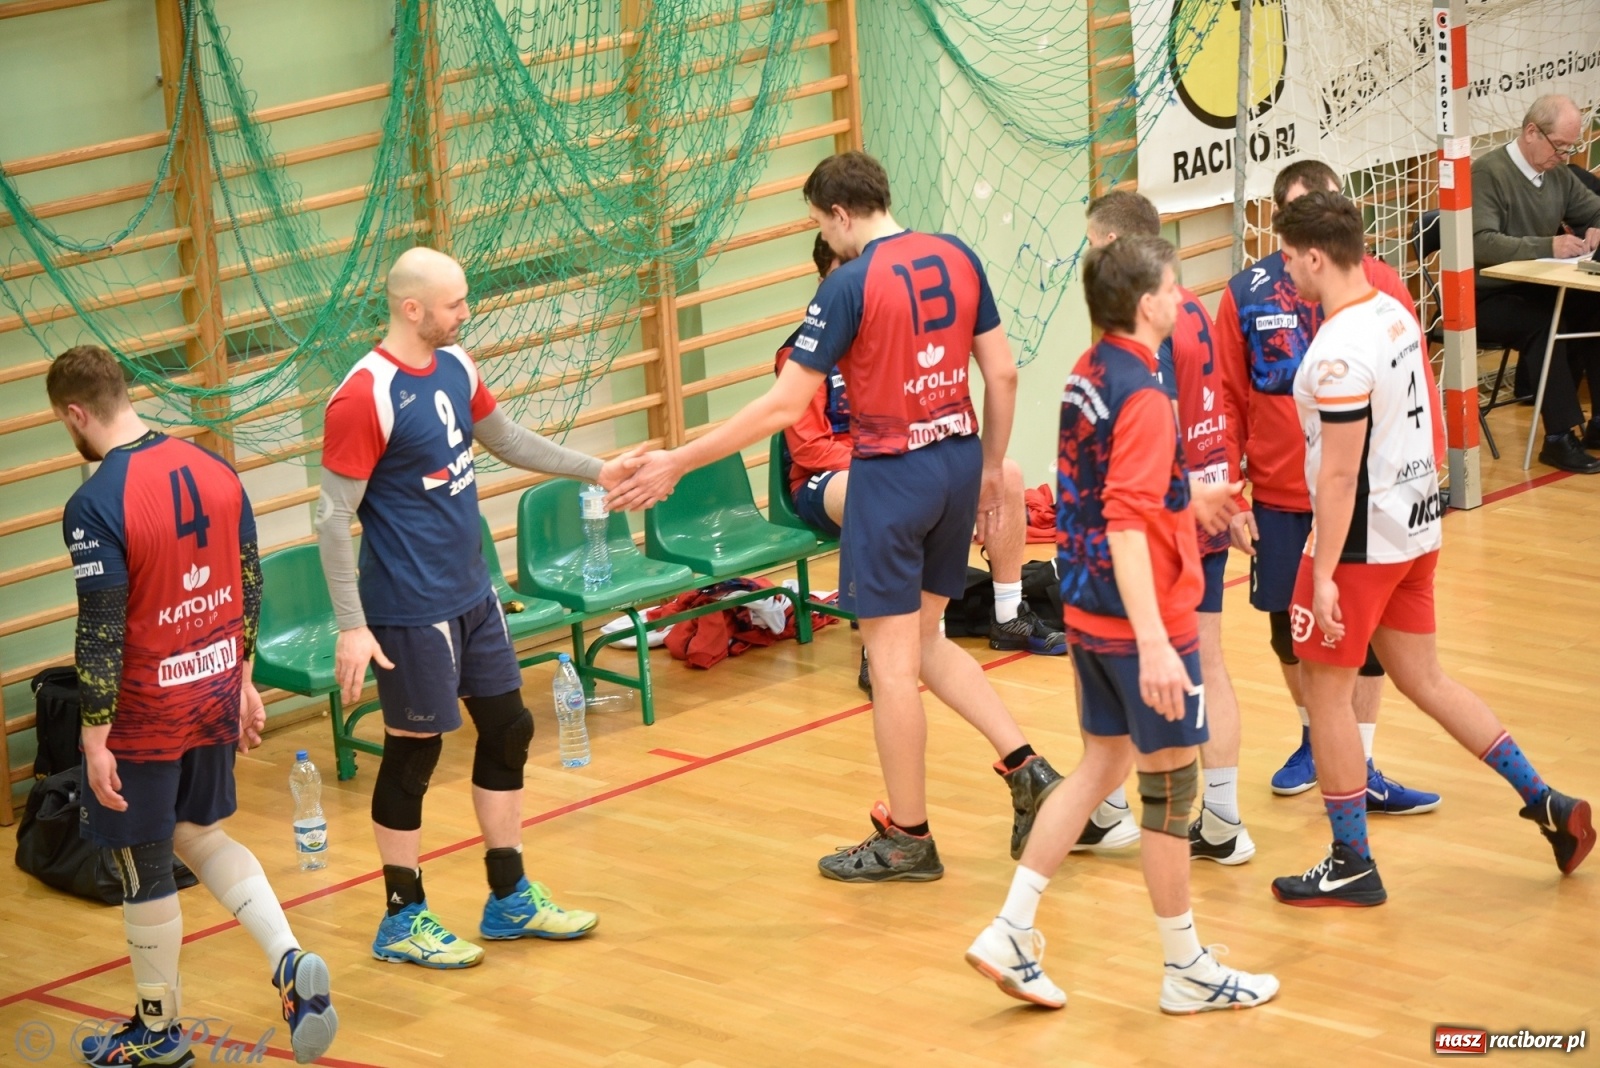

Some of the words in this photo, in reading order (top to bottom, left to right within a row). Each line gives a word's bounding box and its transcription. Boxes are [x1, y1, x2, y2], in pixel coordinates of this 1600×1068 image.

[1173, 122, 1299, 183] RACIÓRZ
[892, 254, 957, 336] 13
[435, 389, 463, 448] 2
[169, 465, 211, 549] 4
[158, 585, 233, 626] KATOLIK
[161, 638, 235, 682] nowiny.pl
